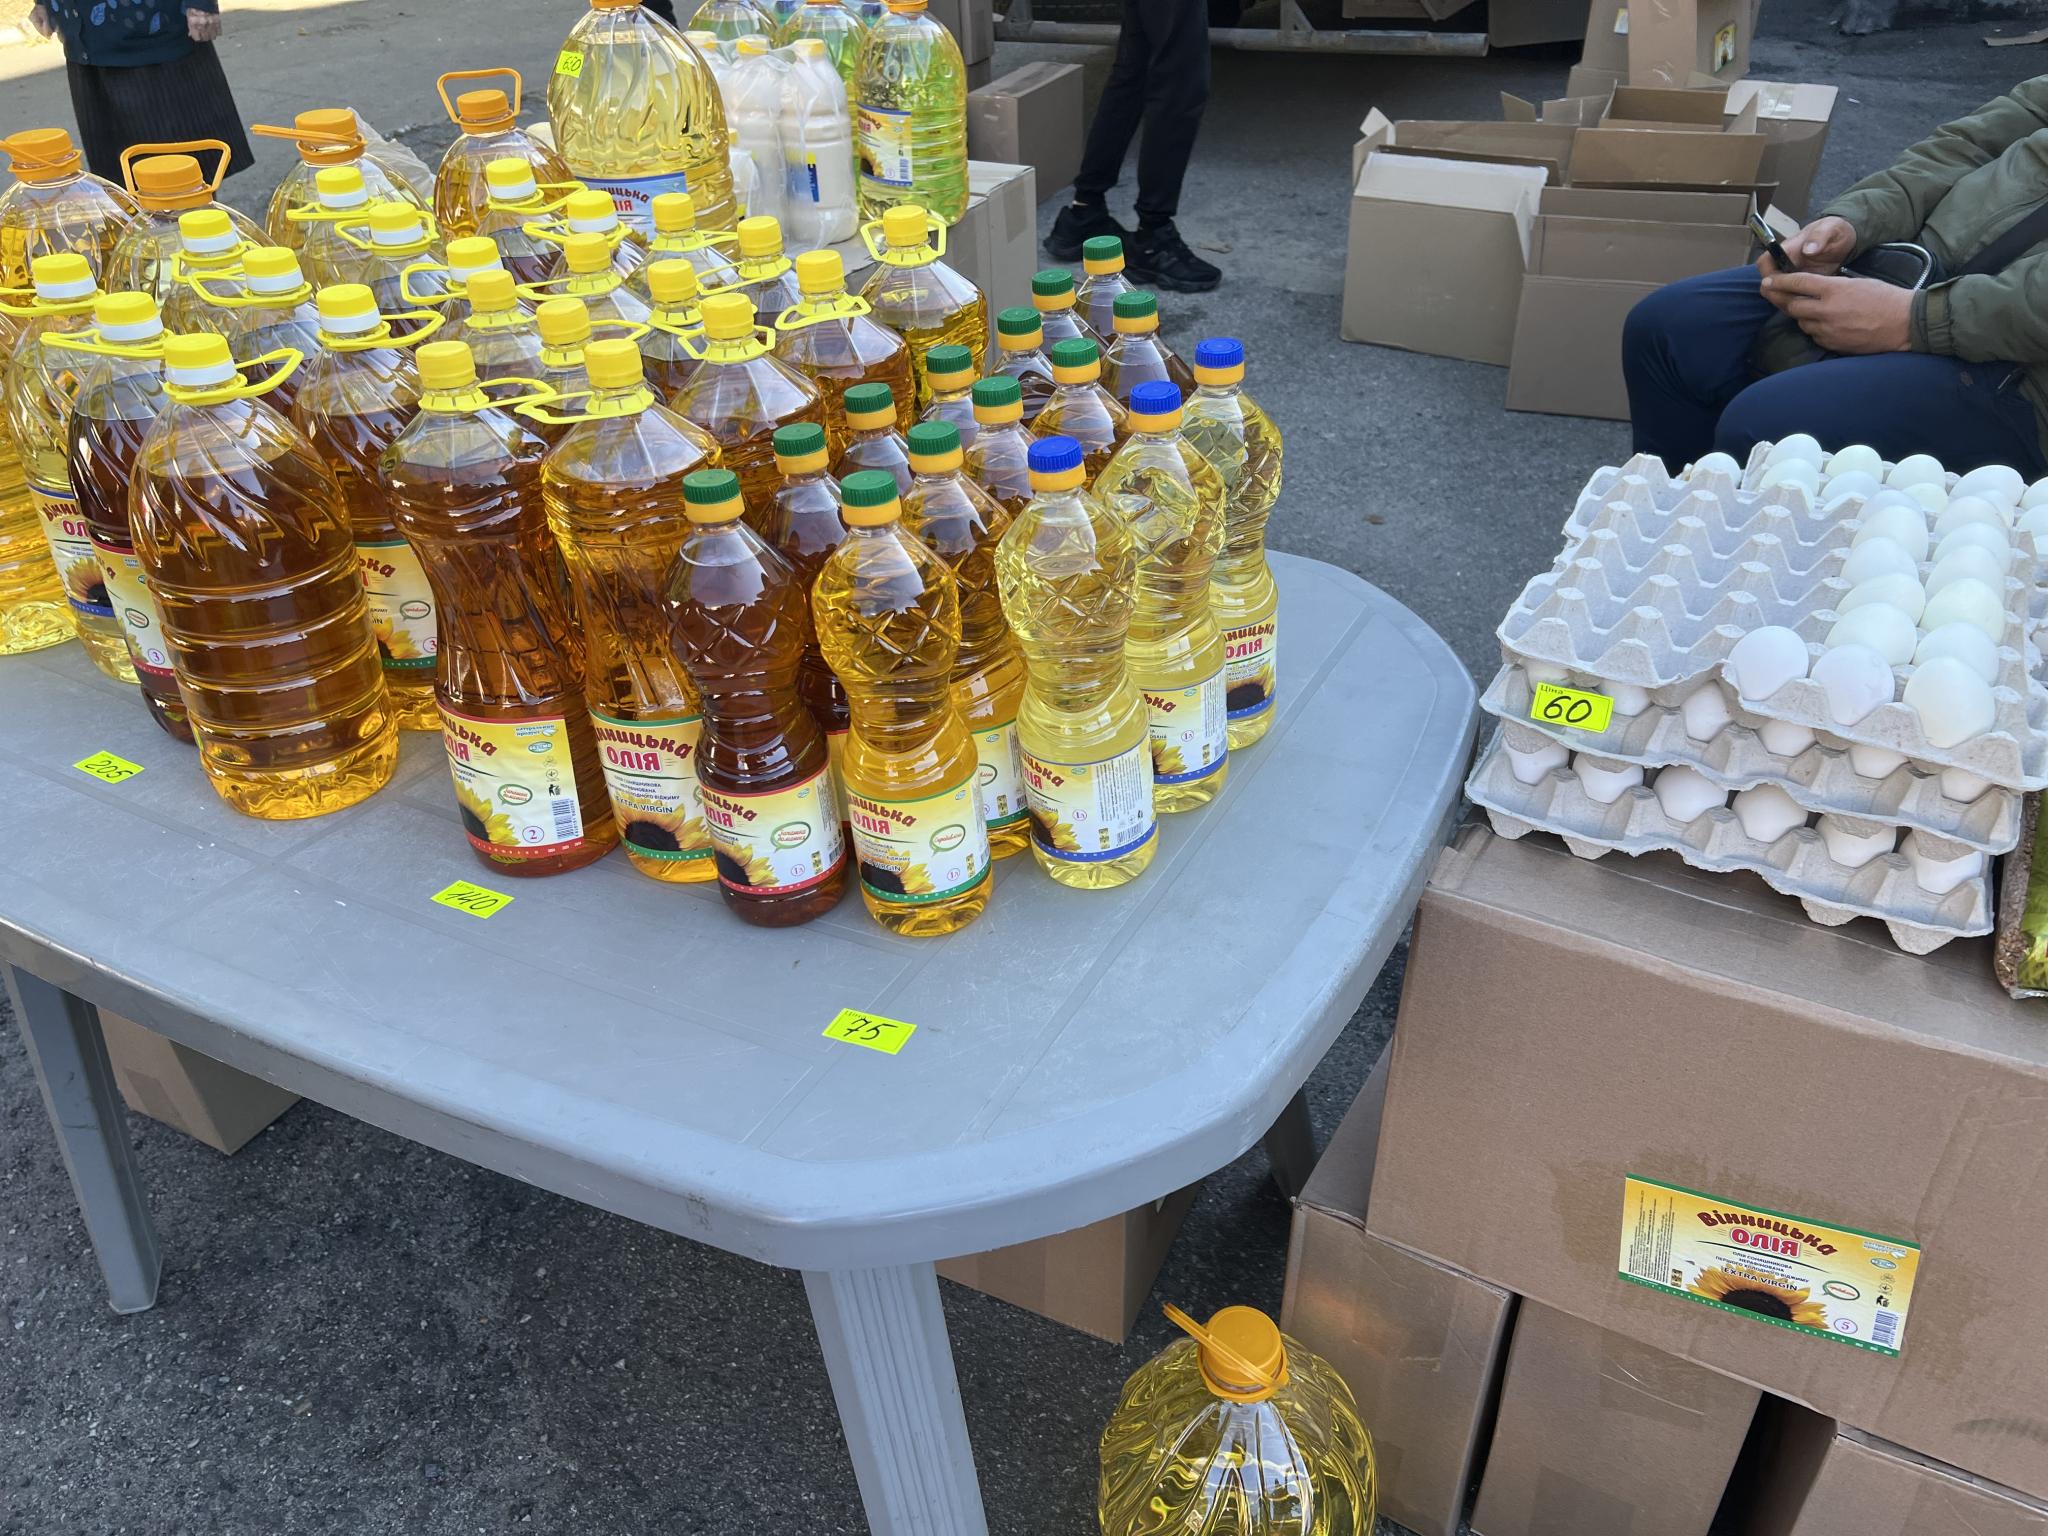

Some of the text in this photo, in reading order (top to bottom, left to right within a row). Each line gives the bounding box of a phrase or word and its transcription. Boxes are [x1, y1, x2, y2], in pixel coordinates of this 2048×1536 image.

[153, 650, 161, 662] 3
[1544, 696, 1592, 723] 60
[84, 760, 134, 778] 205
[606, 746, 661, 771] ОЛІЯ
[640, 804, 673, 814] VIRGIN
[852, 810, 891, 835] ОЛІЯ
[528, 829, 538, 840] 2
[445, 891, 499, 910] 140
[843, 1018, 899, 1041] 75
[1697, 1210, 1838, 1256] Вінницька
[1731, 1228, 1799, 1257] ОЛІЯ
[1724, 1267, 1798, 1291] EXTRA VIRGIN
[1841, 1321, 1850, 1331] 5
